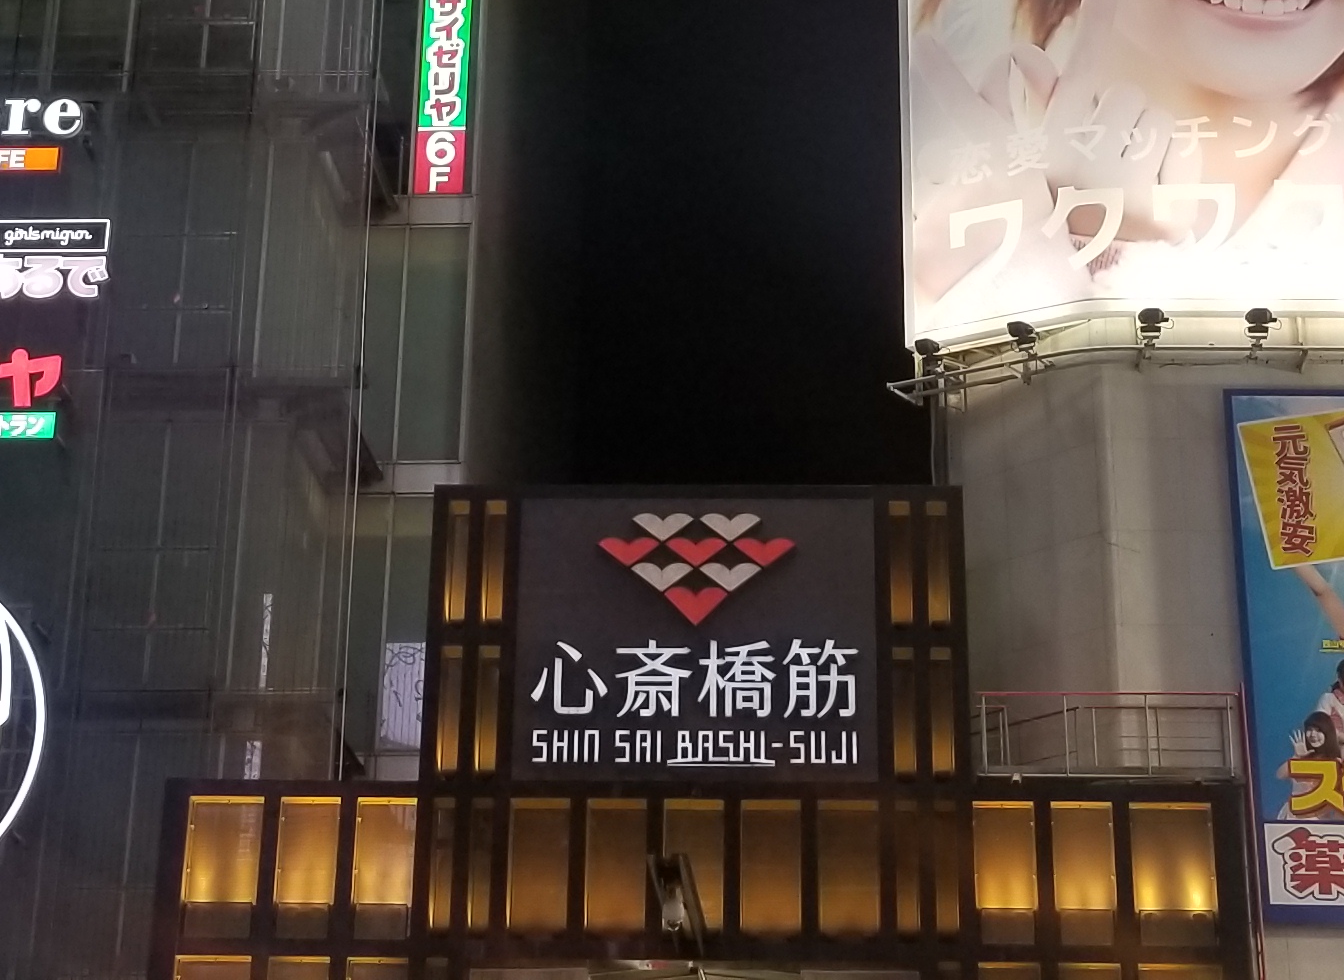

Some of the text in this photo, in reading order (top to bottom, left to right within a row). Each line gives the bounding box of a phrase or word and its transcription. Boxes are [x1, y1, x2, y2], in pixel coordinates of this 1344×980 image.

[425, 130, 457, 193] 6F
[1271, 424, 1316, 557] 元気激安
[529, 638, 860, 719] 心斎橋筋
[532, 729, 601, 764] SHIN
[614, 729, 662, 764] SAI
